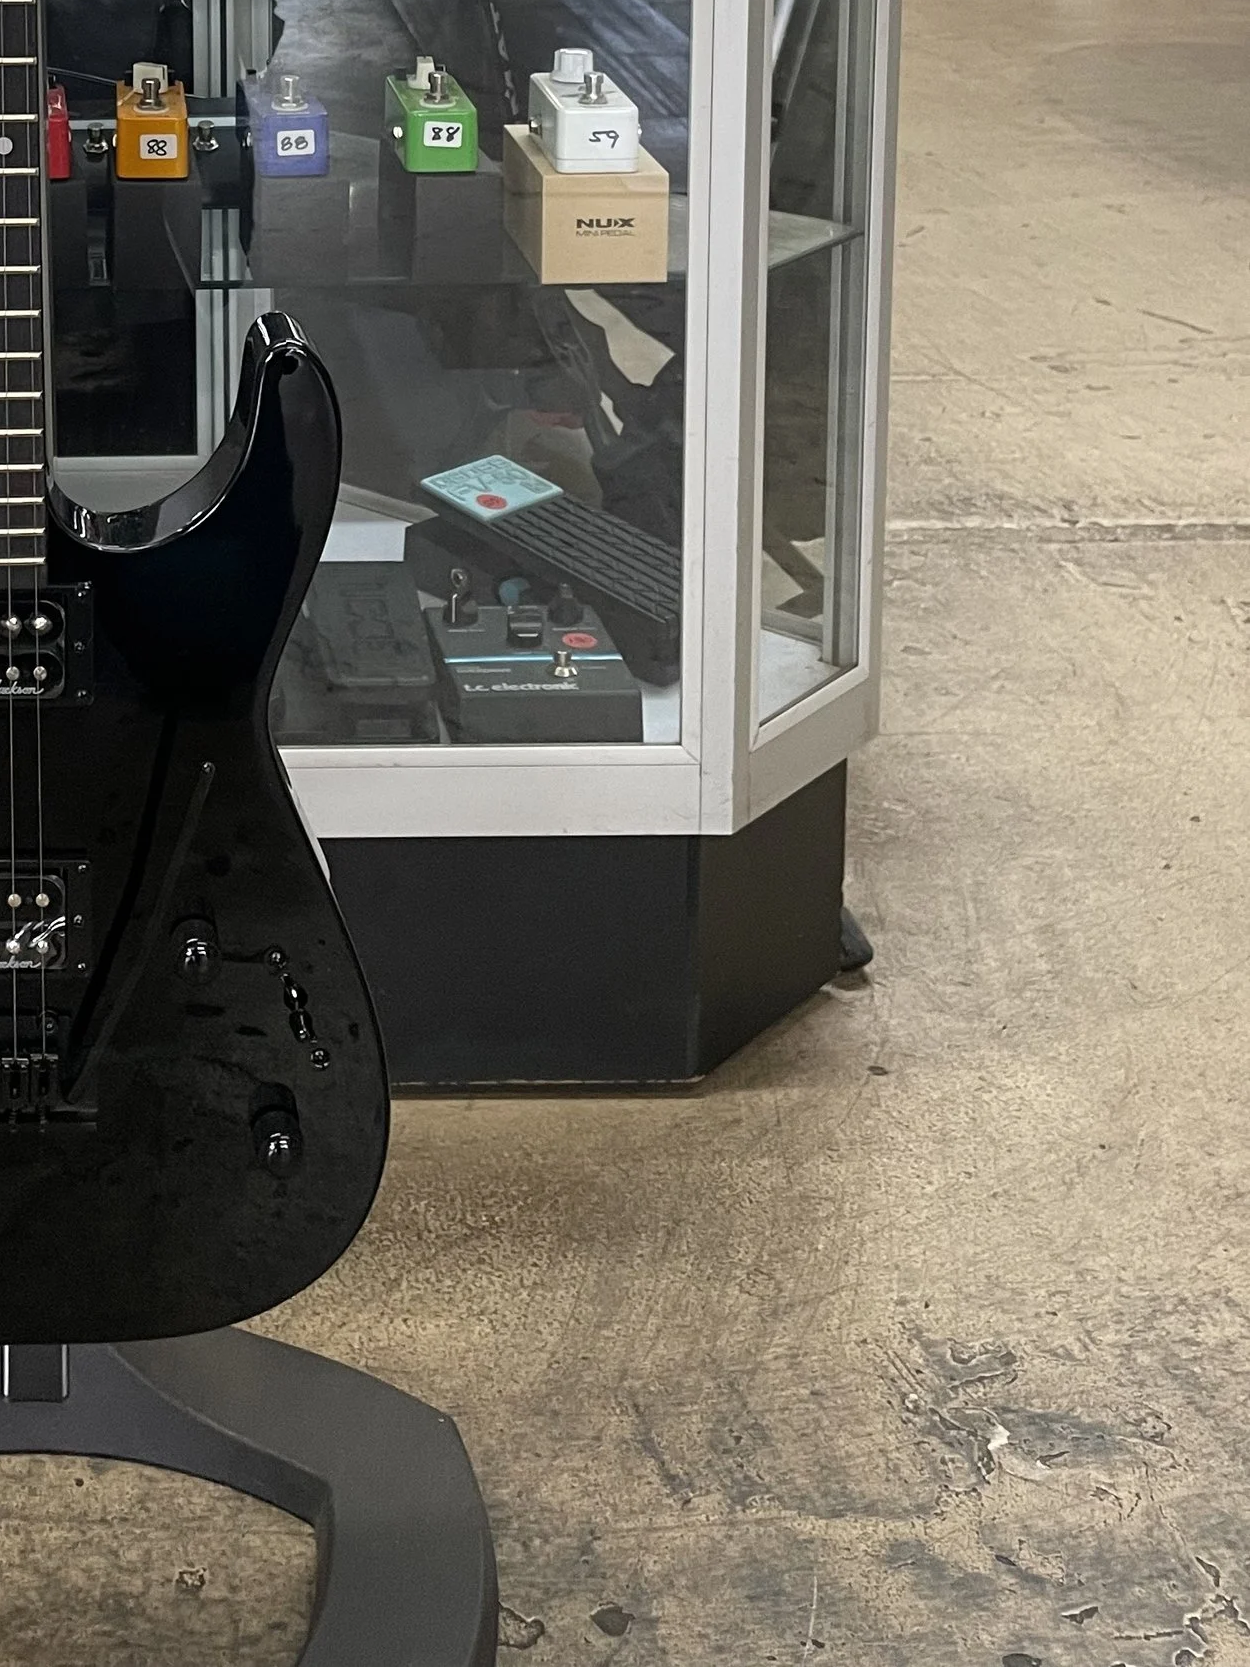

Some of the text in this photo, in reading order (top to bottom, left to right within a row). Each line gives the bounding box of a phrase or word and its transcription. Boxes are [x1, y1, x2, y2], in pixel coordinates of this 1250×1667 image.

[431, 126, 461, 143] 88
[589, 129, 620, 149] 59
[146, 138, 168, 157] 88
[280, 135, 309, 152] 88
[576, 217, 635, 229] NUX
